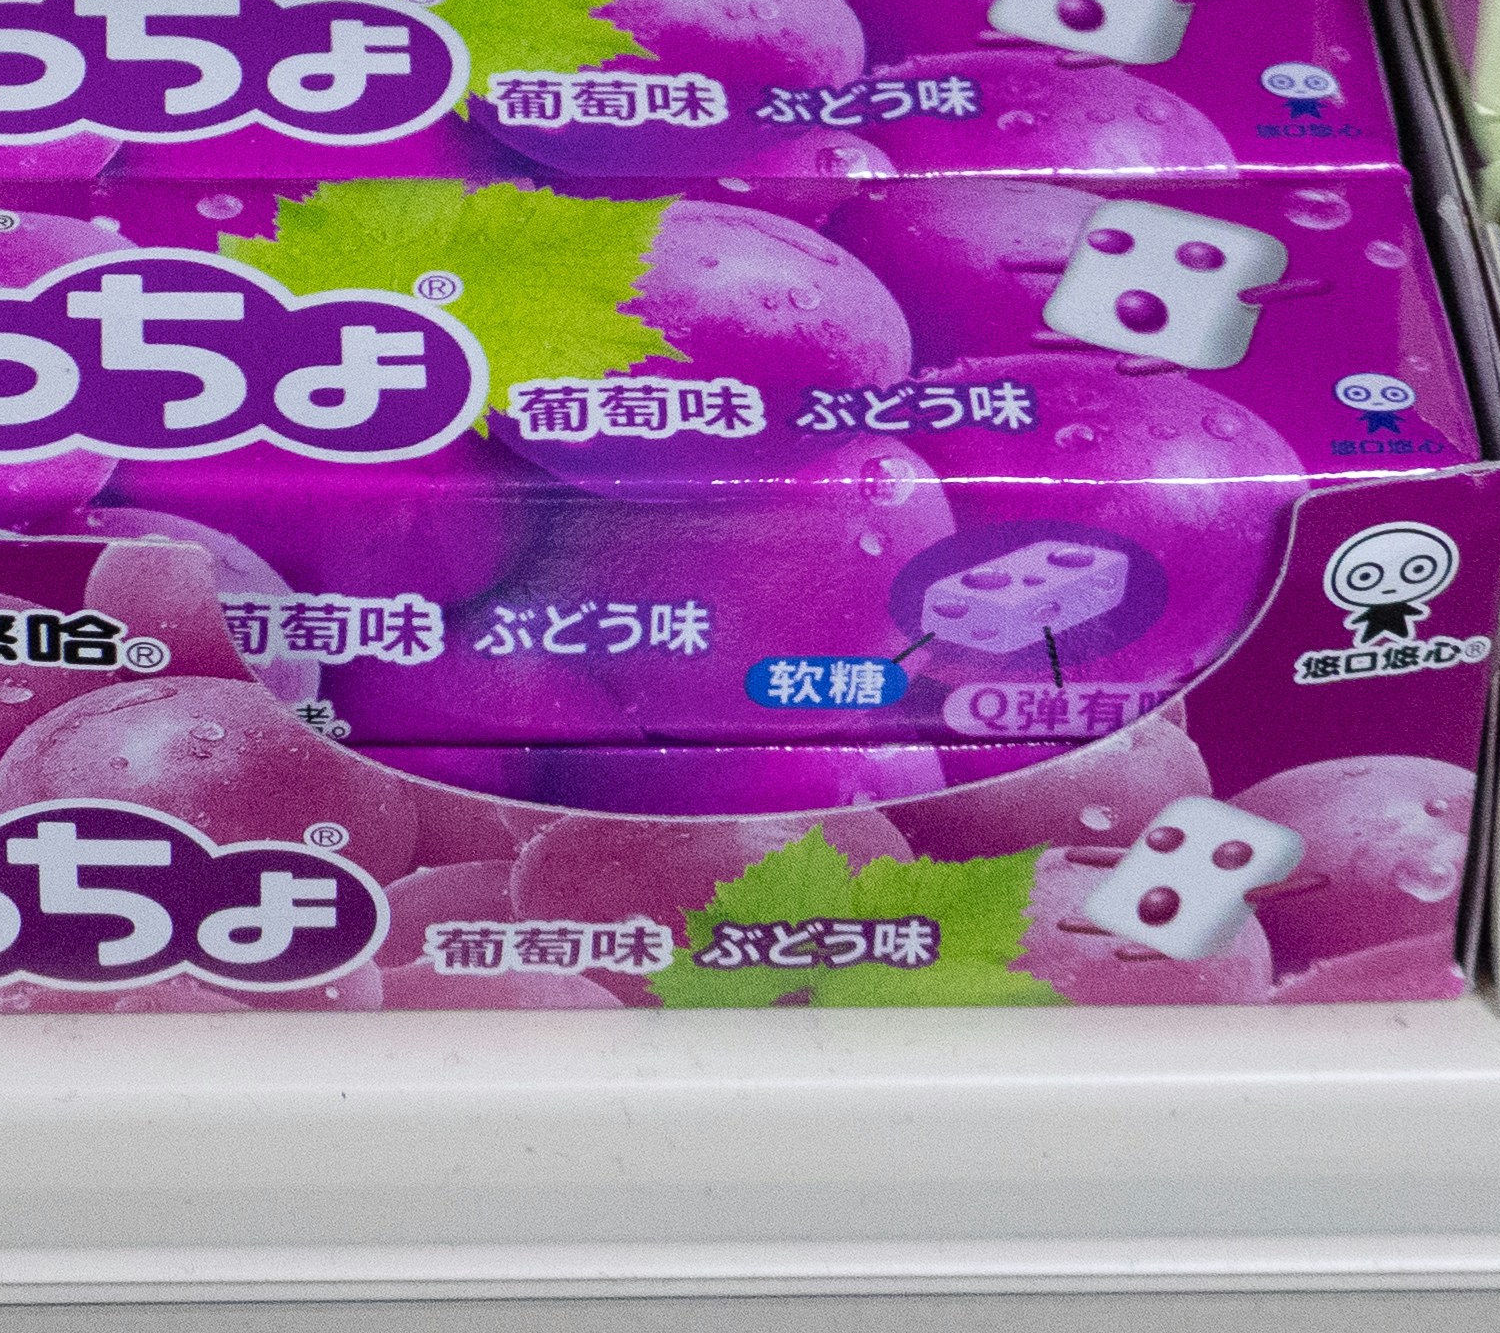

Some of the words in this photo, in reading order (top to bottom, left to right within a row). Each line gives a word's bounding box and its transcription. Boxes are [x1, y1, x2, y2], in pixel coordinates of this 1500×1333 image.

[498, 78, 721, 123] 葡萄味
[758, 80, 977, 123] ぶどう味
[522, 383, 755, 433] 葡萄味
[799, 383, 1034, 431] ぶどう味
[473, 605, 711, 654] ぶどう味
[768, 659, 886, 705] 软糖
[1301, 642, 1461, 680] 悠口悠心
[969, 688, 1178, 731] Q弹有
[436, 929, 664, 968] 葡萄味
[701, 923, 935, 966] ぶどう味
